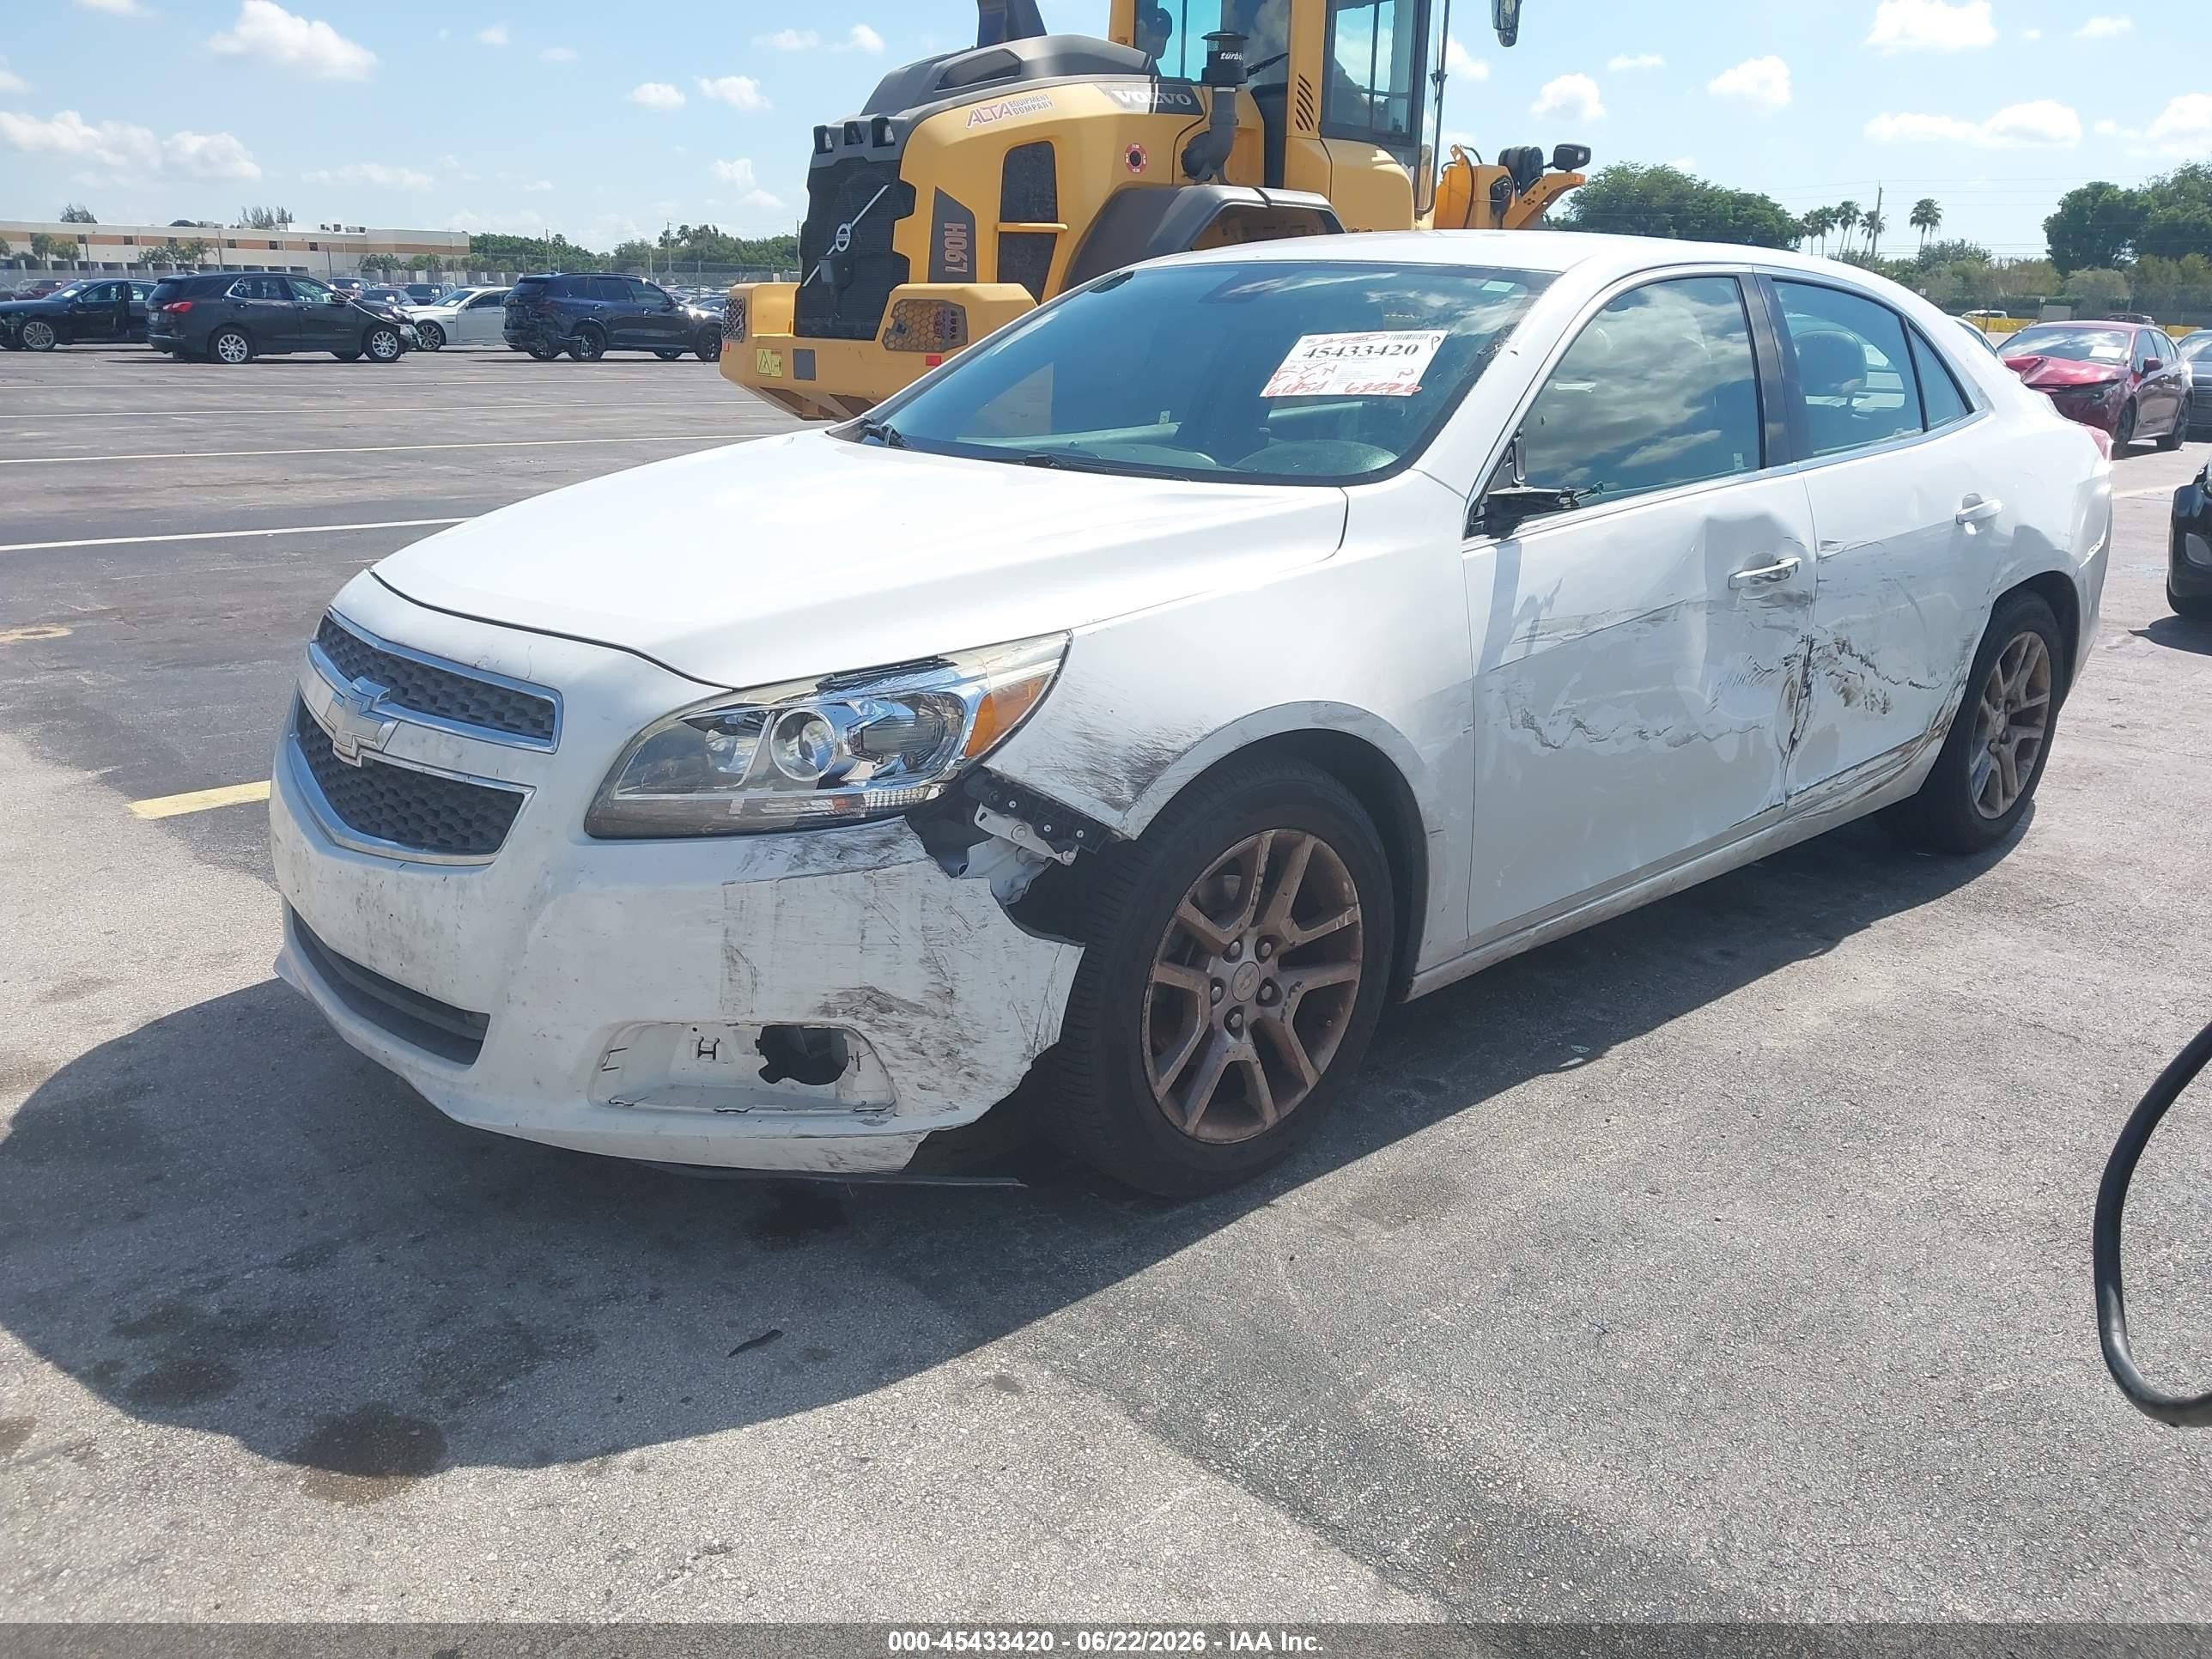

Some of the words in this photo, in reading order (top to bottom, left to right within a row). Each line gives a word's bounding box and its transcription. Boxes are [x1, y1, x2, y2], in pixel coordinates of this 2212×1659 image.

[1008, 94, 1050, 108] EQUIPMENT
[1110, 89, 1192, 106] VOLVO
[966, 102, 1013, 127] ALTA
[1012, 100, 1054, 115] COMPANY
[1302, 343, 1420, 359] 45433420
